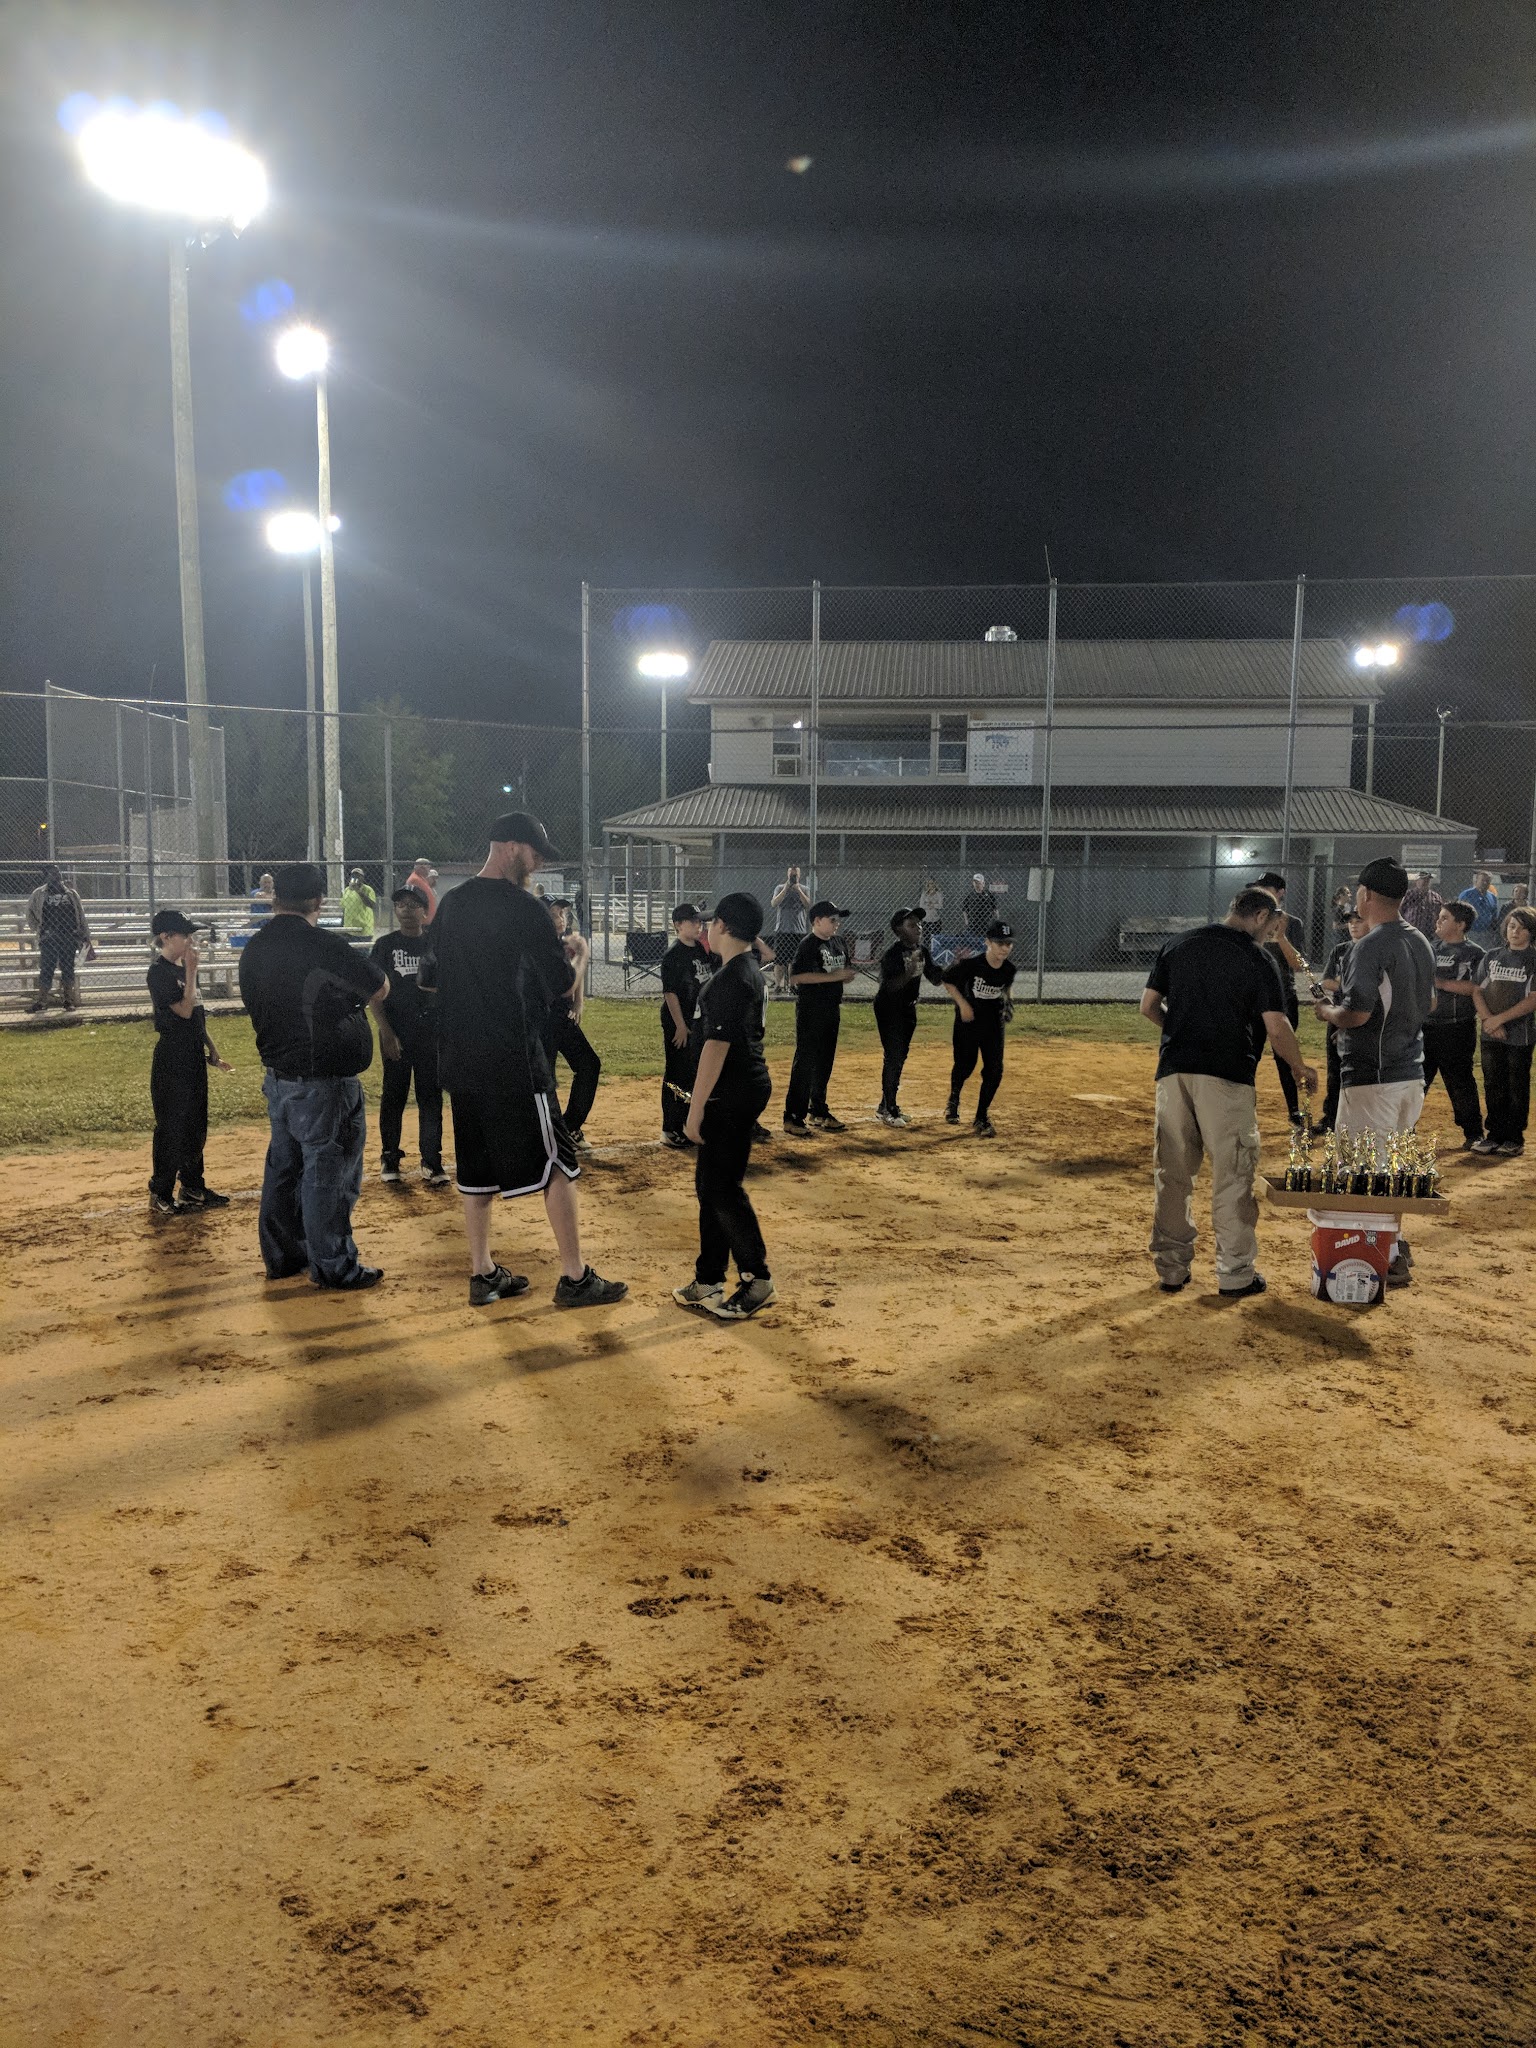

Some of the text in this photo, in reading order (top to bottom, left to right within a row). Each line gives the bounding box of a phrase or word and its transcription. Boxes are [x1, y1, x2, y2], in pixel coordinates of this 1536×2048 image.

[391, 948, 421, 967] Vinc
[1488, 959, 1527, 979] Vincent
[1334, 1234, 1360, 1249] DAVID
